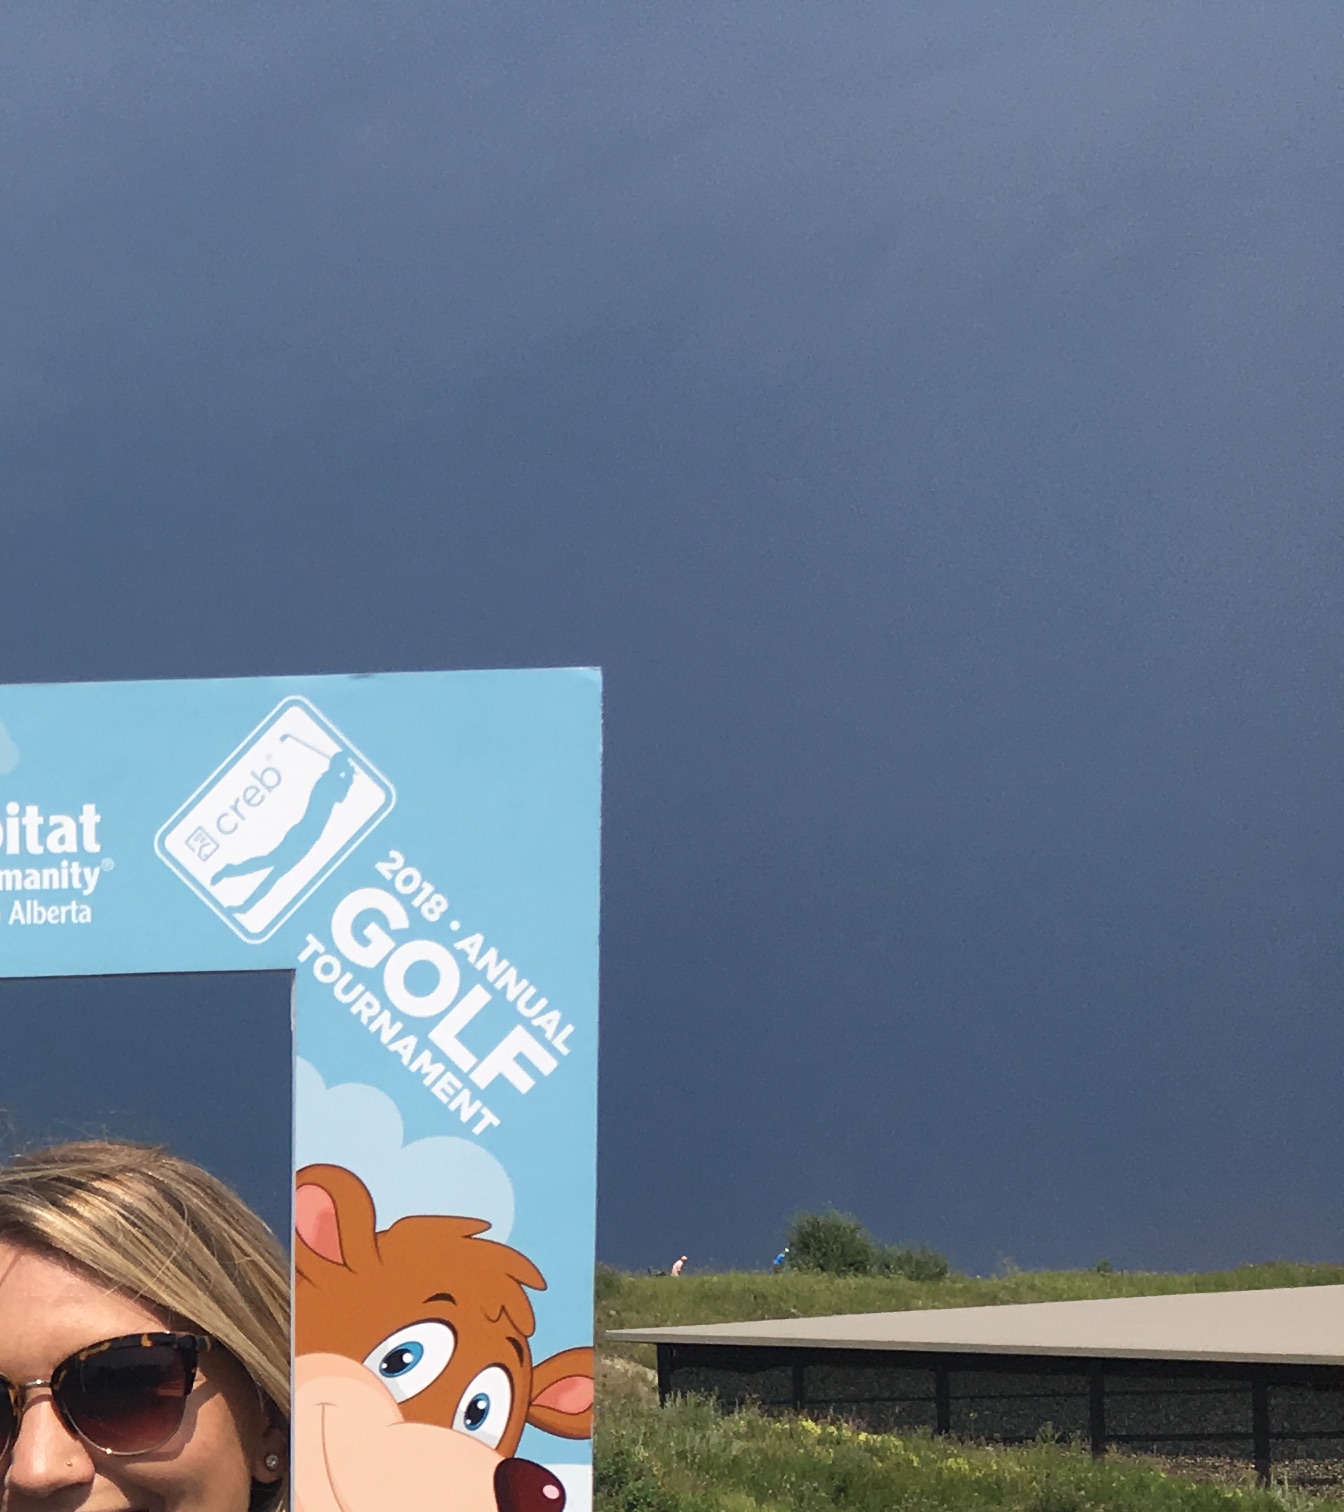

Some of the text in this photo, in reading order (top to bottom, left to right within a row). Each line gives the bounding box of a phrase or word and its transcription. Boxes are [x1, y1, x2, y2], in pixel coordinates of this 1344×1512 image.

[214, 765, 282, 836] creb
[8, 900, 93, 926] Alberta
[330, 887, 559, 1095] GOLF
[374, 850, 576, 1057] 2018 ANNUAL
[296, 933, 502, 1136] TOURNAMENT
